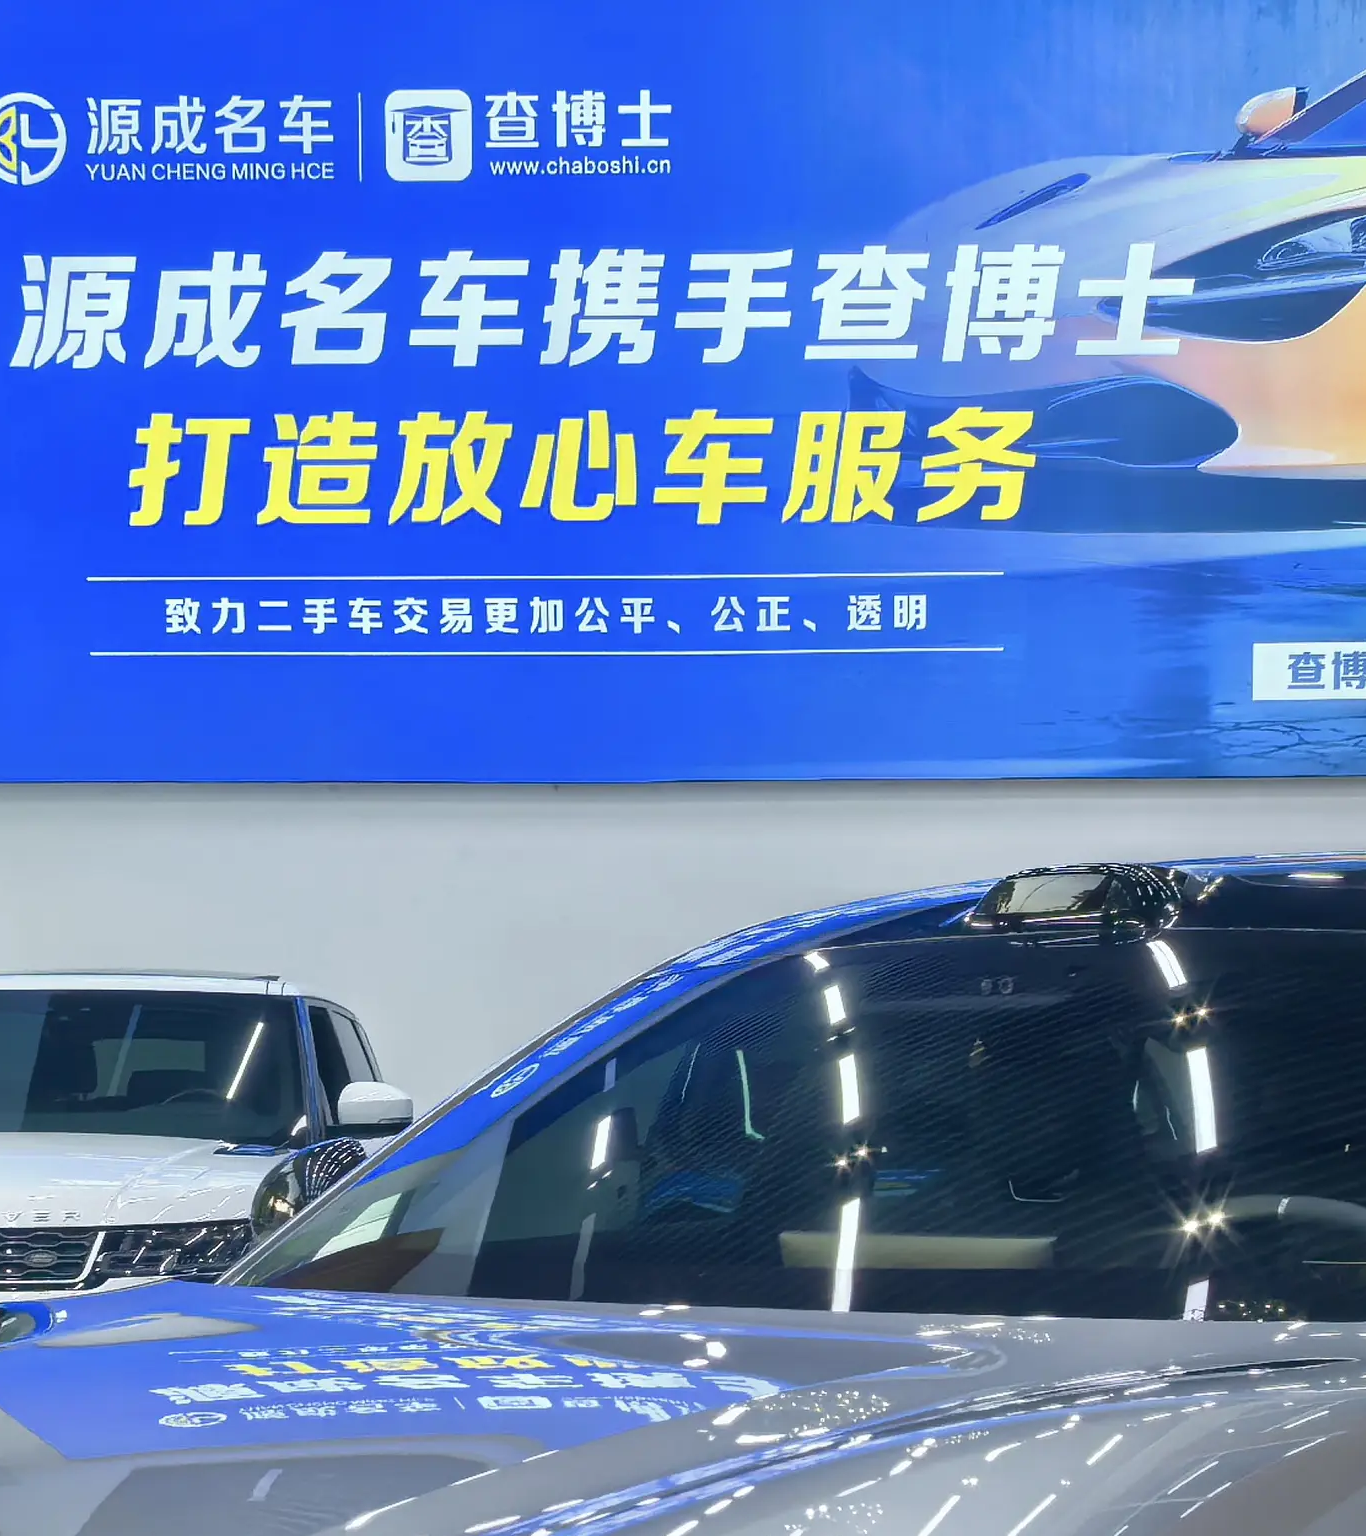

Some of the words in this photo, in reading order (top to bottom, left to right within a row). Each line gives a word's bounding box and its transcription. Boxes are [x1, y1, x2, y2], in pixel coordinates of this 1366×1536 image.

[86, 94, 334, 155] 源成名车
[484, 89, 673, 148] 查博士
[85, 164, 146, 181] YUAN
[152, 163, 226, 181] CHENG
[232, 163, 285, 181] MING
[291, 162, 334, 180] HCE
[490, 156, 672, 177] www.chaboshi.cn
[8, 242, 1196, 369] 源成名车携手查博士
[129, 405, 1036, 526] 打造放心车服务
